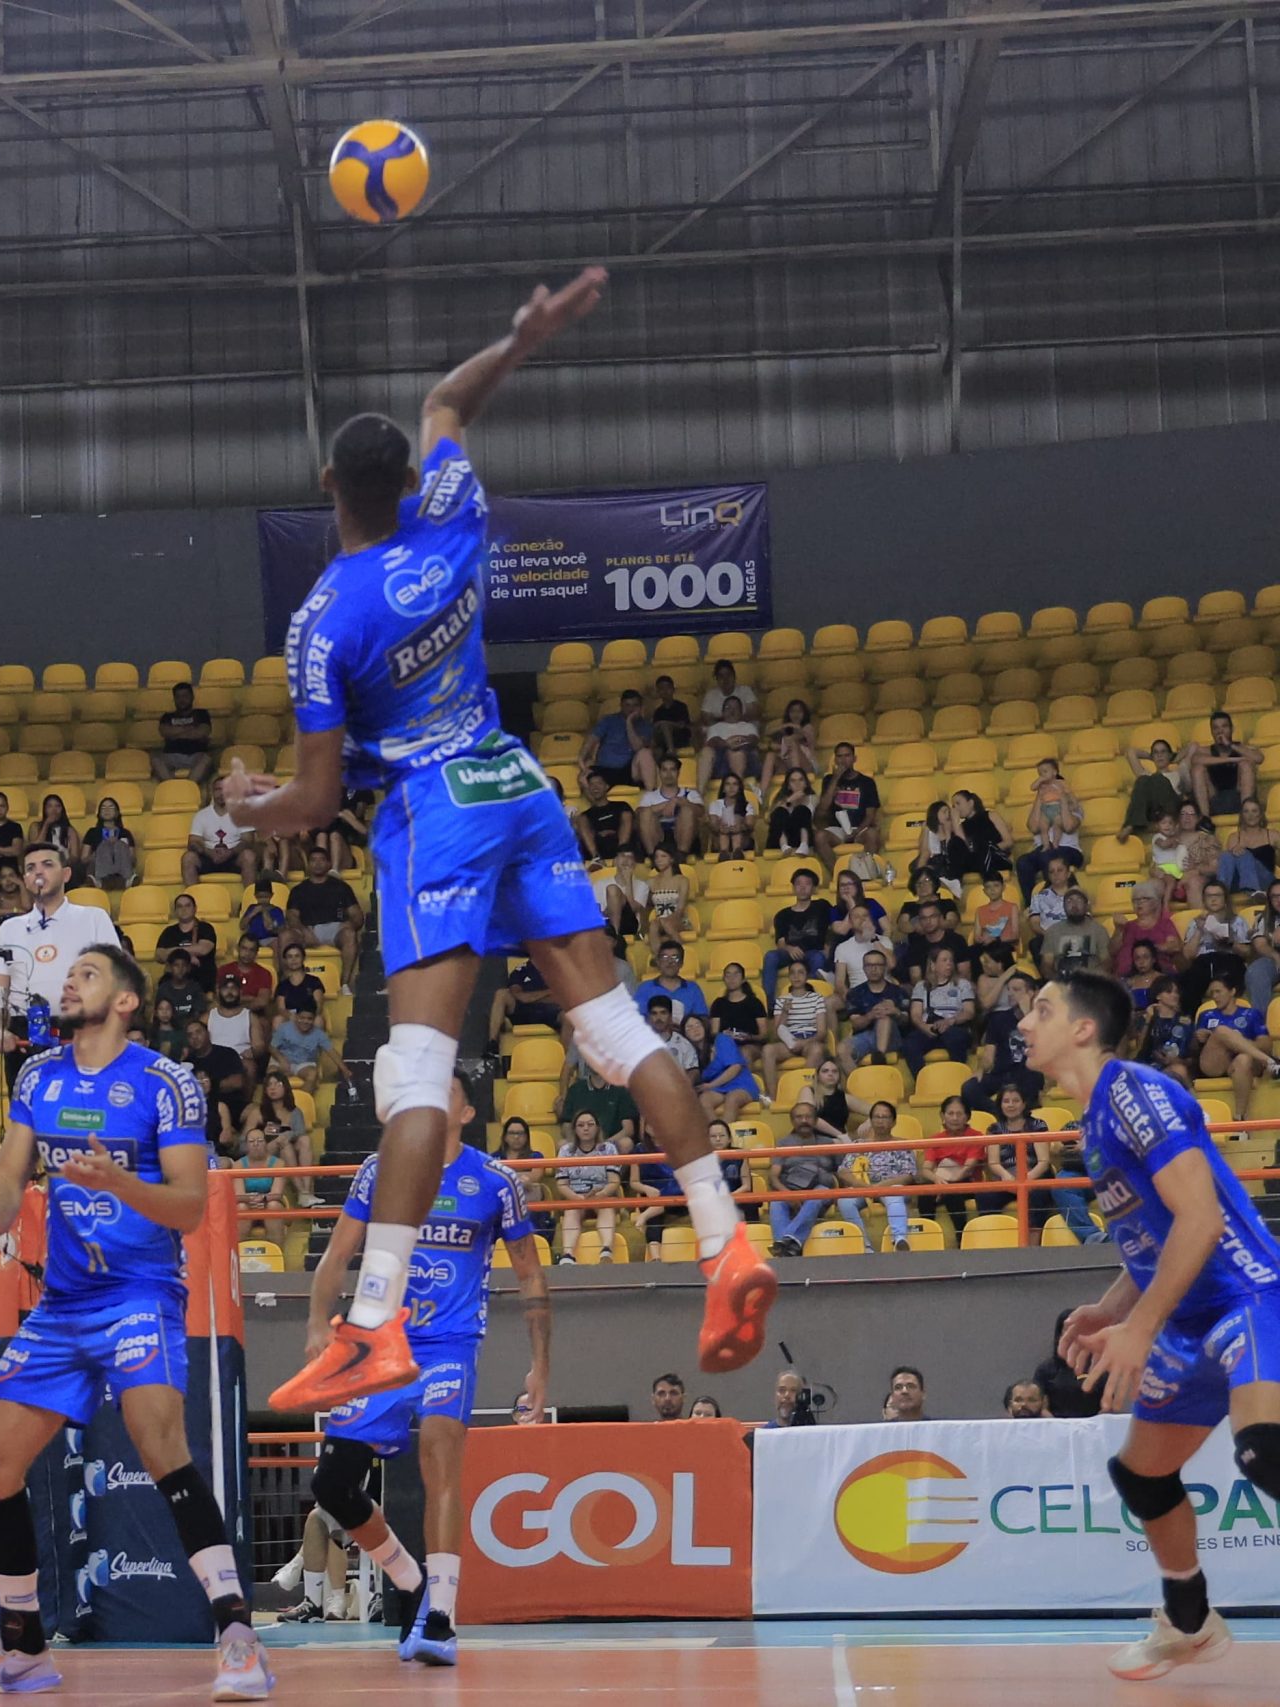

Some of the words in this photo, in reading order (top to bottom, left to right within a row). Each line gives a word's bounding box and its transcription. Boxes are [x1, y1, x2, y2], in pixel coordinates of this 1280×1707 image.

[489, 542, 500, 554] A
[503, 539, 564, 553] conexão
[489, 558, 517, 571] que
[521, 556, 549, 567] leva
[553, 552, 587, 565] você
[606, 556, 652, 567] PLANOS
[655, 555, 671, 564] DE
[395, 564, 446, 605] EMS
[491, 574, 508, 584] na
[512, 568, 589, 582] velocidade
[604, 562, 745, 611] 1000
[745, 560, 757, 603] MEGAS
[491, 588, 509, 599] de
[513, 588, 536, 597] um
[540, 583, 588, 598] saque!
[394, 588, 477, 678] Renata
[153, 1057, 201, 1121] Renata
[1111, 1071, 1154, 1147] Renata
[1143, 1082, 1187, 1131] ADERE
[60, 1201, 113, 1216] EMS
[419, 1222, 473, 1244] nata
[410, 1298, 437, 1326] 12
[470, 1471, 732, 1567] GOL
[990, 1478, 1280, 1537] CELPA
[1126, 1537, 1218, 1552] SOES
[1223, 1536, 1248, 1549] EM
[110, 1552, 177, 1580] Superliga
